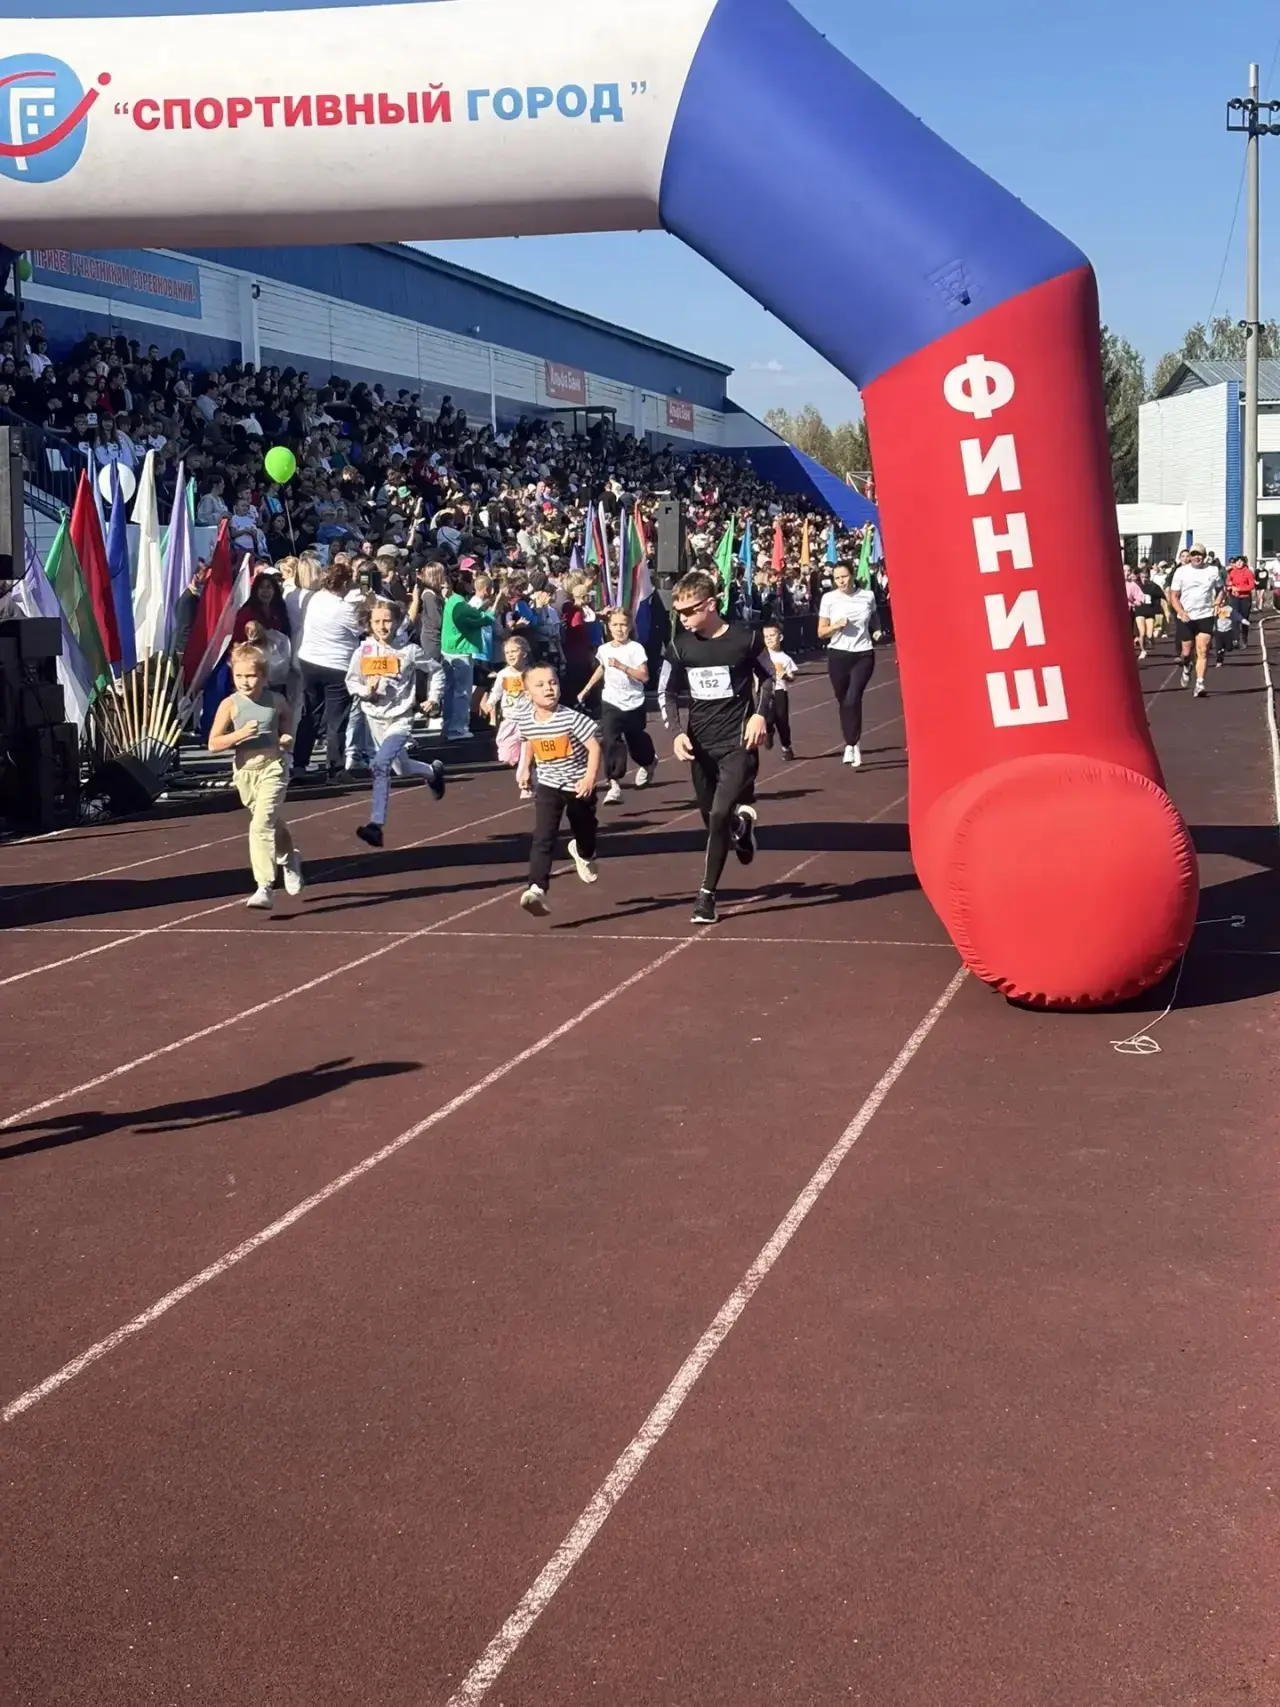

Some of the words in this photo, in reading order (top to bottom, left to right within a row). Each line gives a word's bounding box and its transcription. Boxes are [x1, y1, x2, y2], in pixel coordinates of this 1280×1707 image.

[71, 252, 131, 289] УЧАСТНИКАМ
[943, 354, 1069, 728] ФИНИШ
[372, 660, 388, 670] 229
[699, 679, 720, 689] 152
[540, 740, 556, 752] 198
